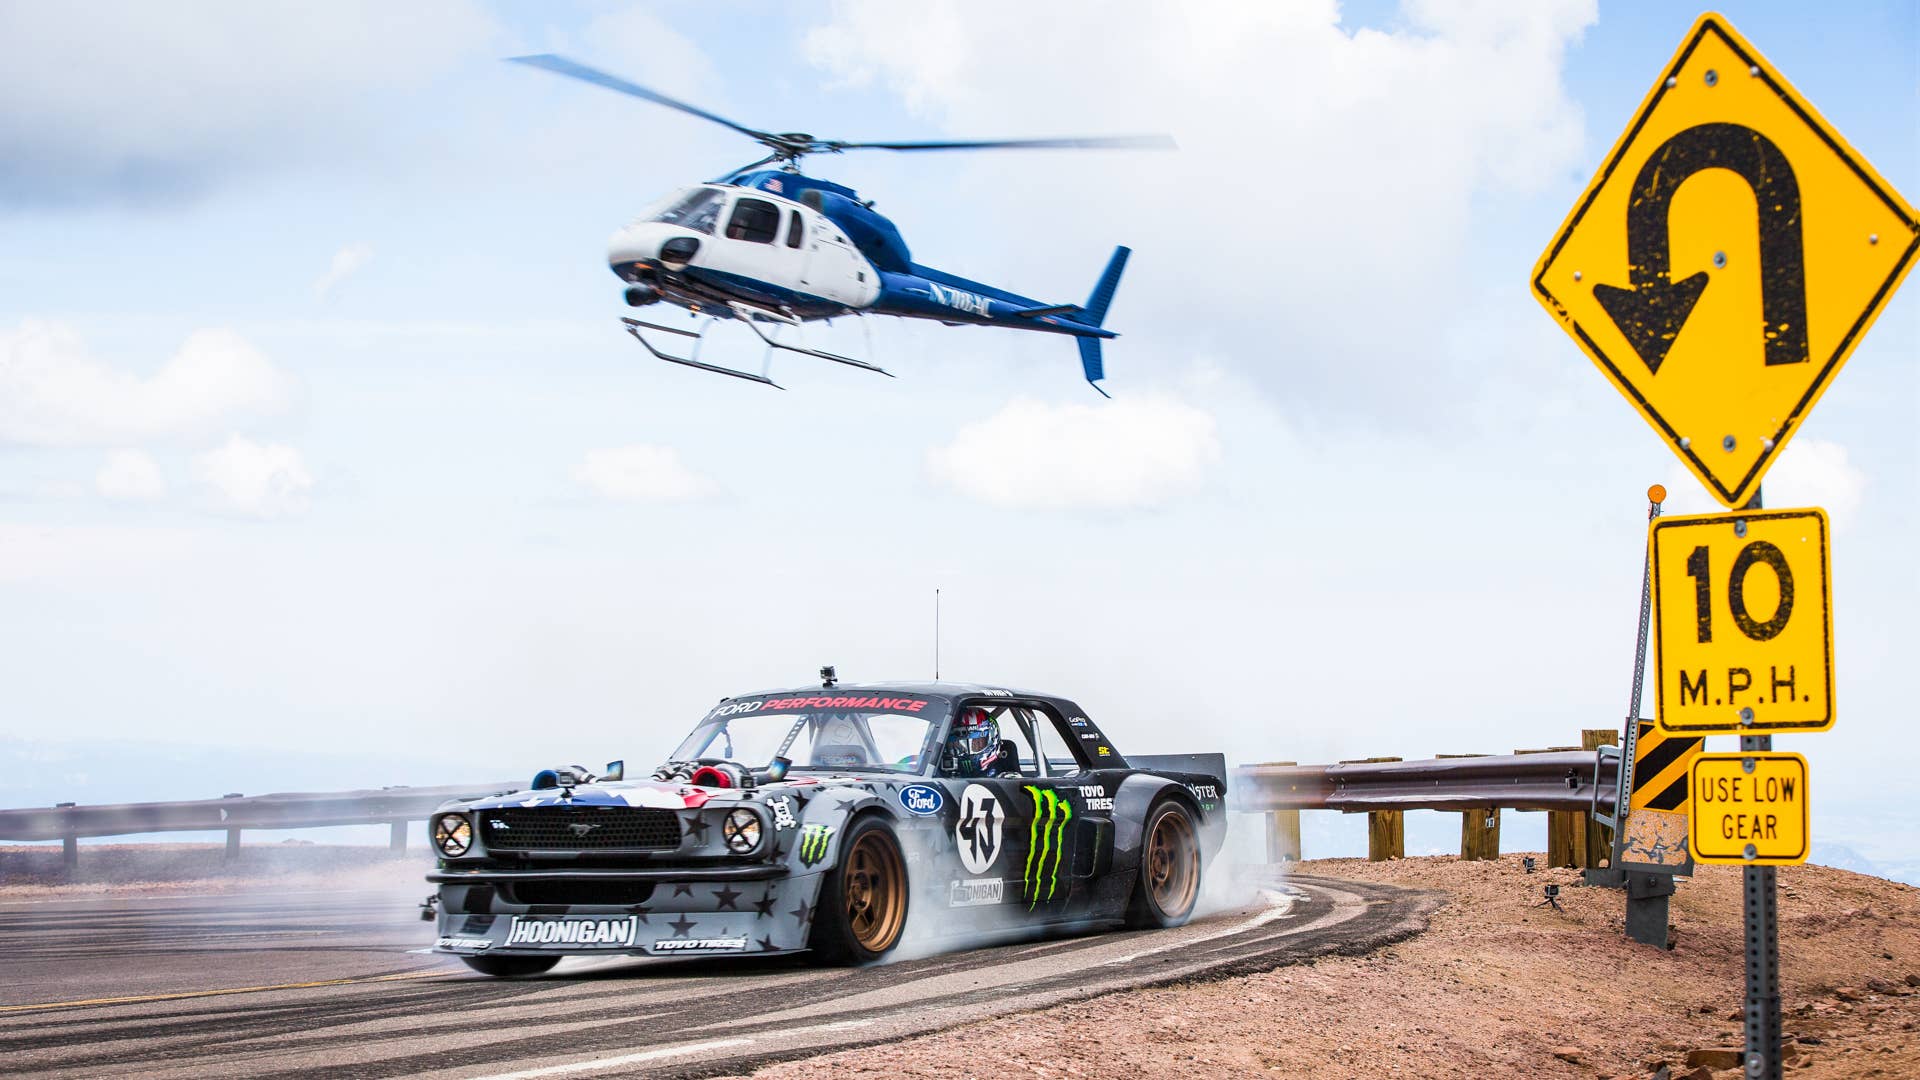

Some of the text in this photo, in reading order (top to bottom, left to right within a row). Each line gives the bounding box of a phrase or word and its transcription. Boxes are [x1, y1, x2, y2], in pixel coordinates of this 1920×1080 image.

[1687, 541, 1794, 643] 10
[1680, 665, 1810, 706] M.P.H.
[710, 697, 928, 719] FORD PERFORMANCE
[907, 788, 936, 810] Ford
[1079, 785, 1105, 797] TOYO
[1702, 777, 1796, 802] USE LOW
[1086, 798, 1113, 810] TIRES
[1722, 814, 1777, 840] GEAR
[504, 916, 639, 946] [HOONIGAN]
[655, 939, 746, 949] TOYO TIRES
